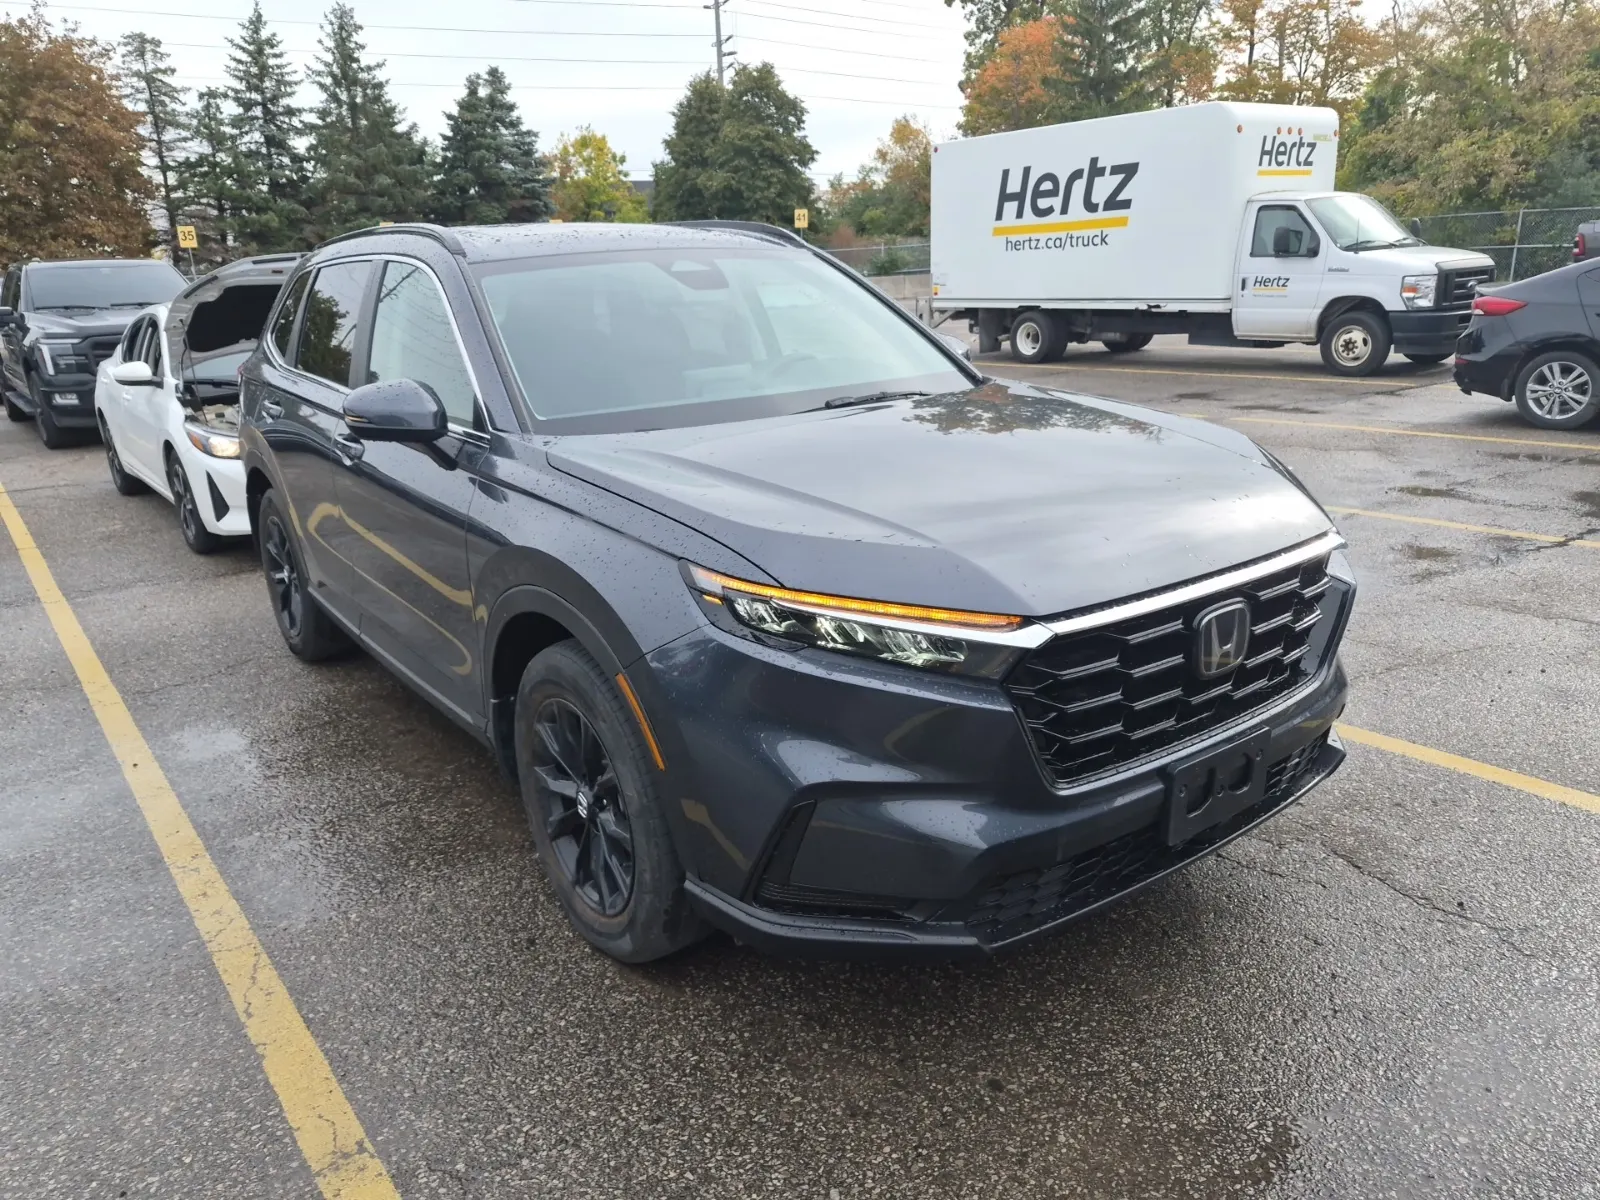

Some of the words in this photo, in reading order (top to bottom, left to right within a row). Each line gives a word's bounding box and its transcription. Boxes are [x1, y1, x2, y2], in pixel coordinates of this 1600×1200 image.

[1258, 135, 1317, 167] Hertz
[995, 156, 1140, 222] Hertz
[796, 213, 806, 222] 41
[180, 230, 194, 241] 35
[1005, 229, 1109, 252] hertz.ca/truck
[1253, 275, 1290, 288] Hertz
